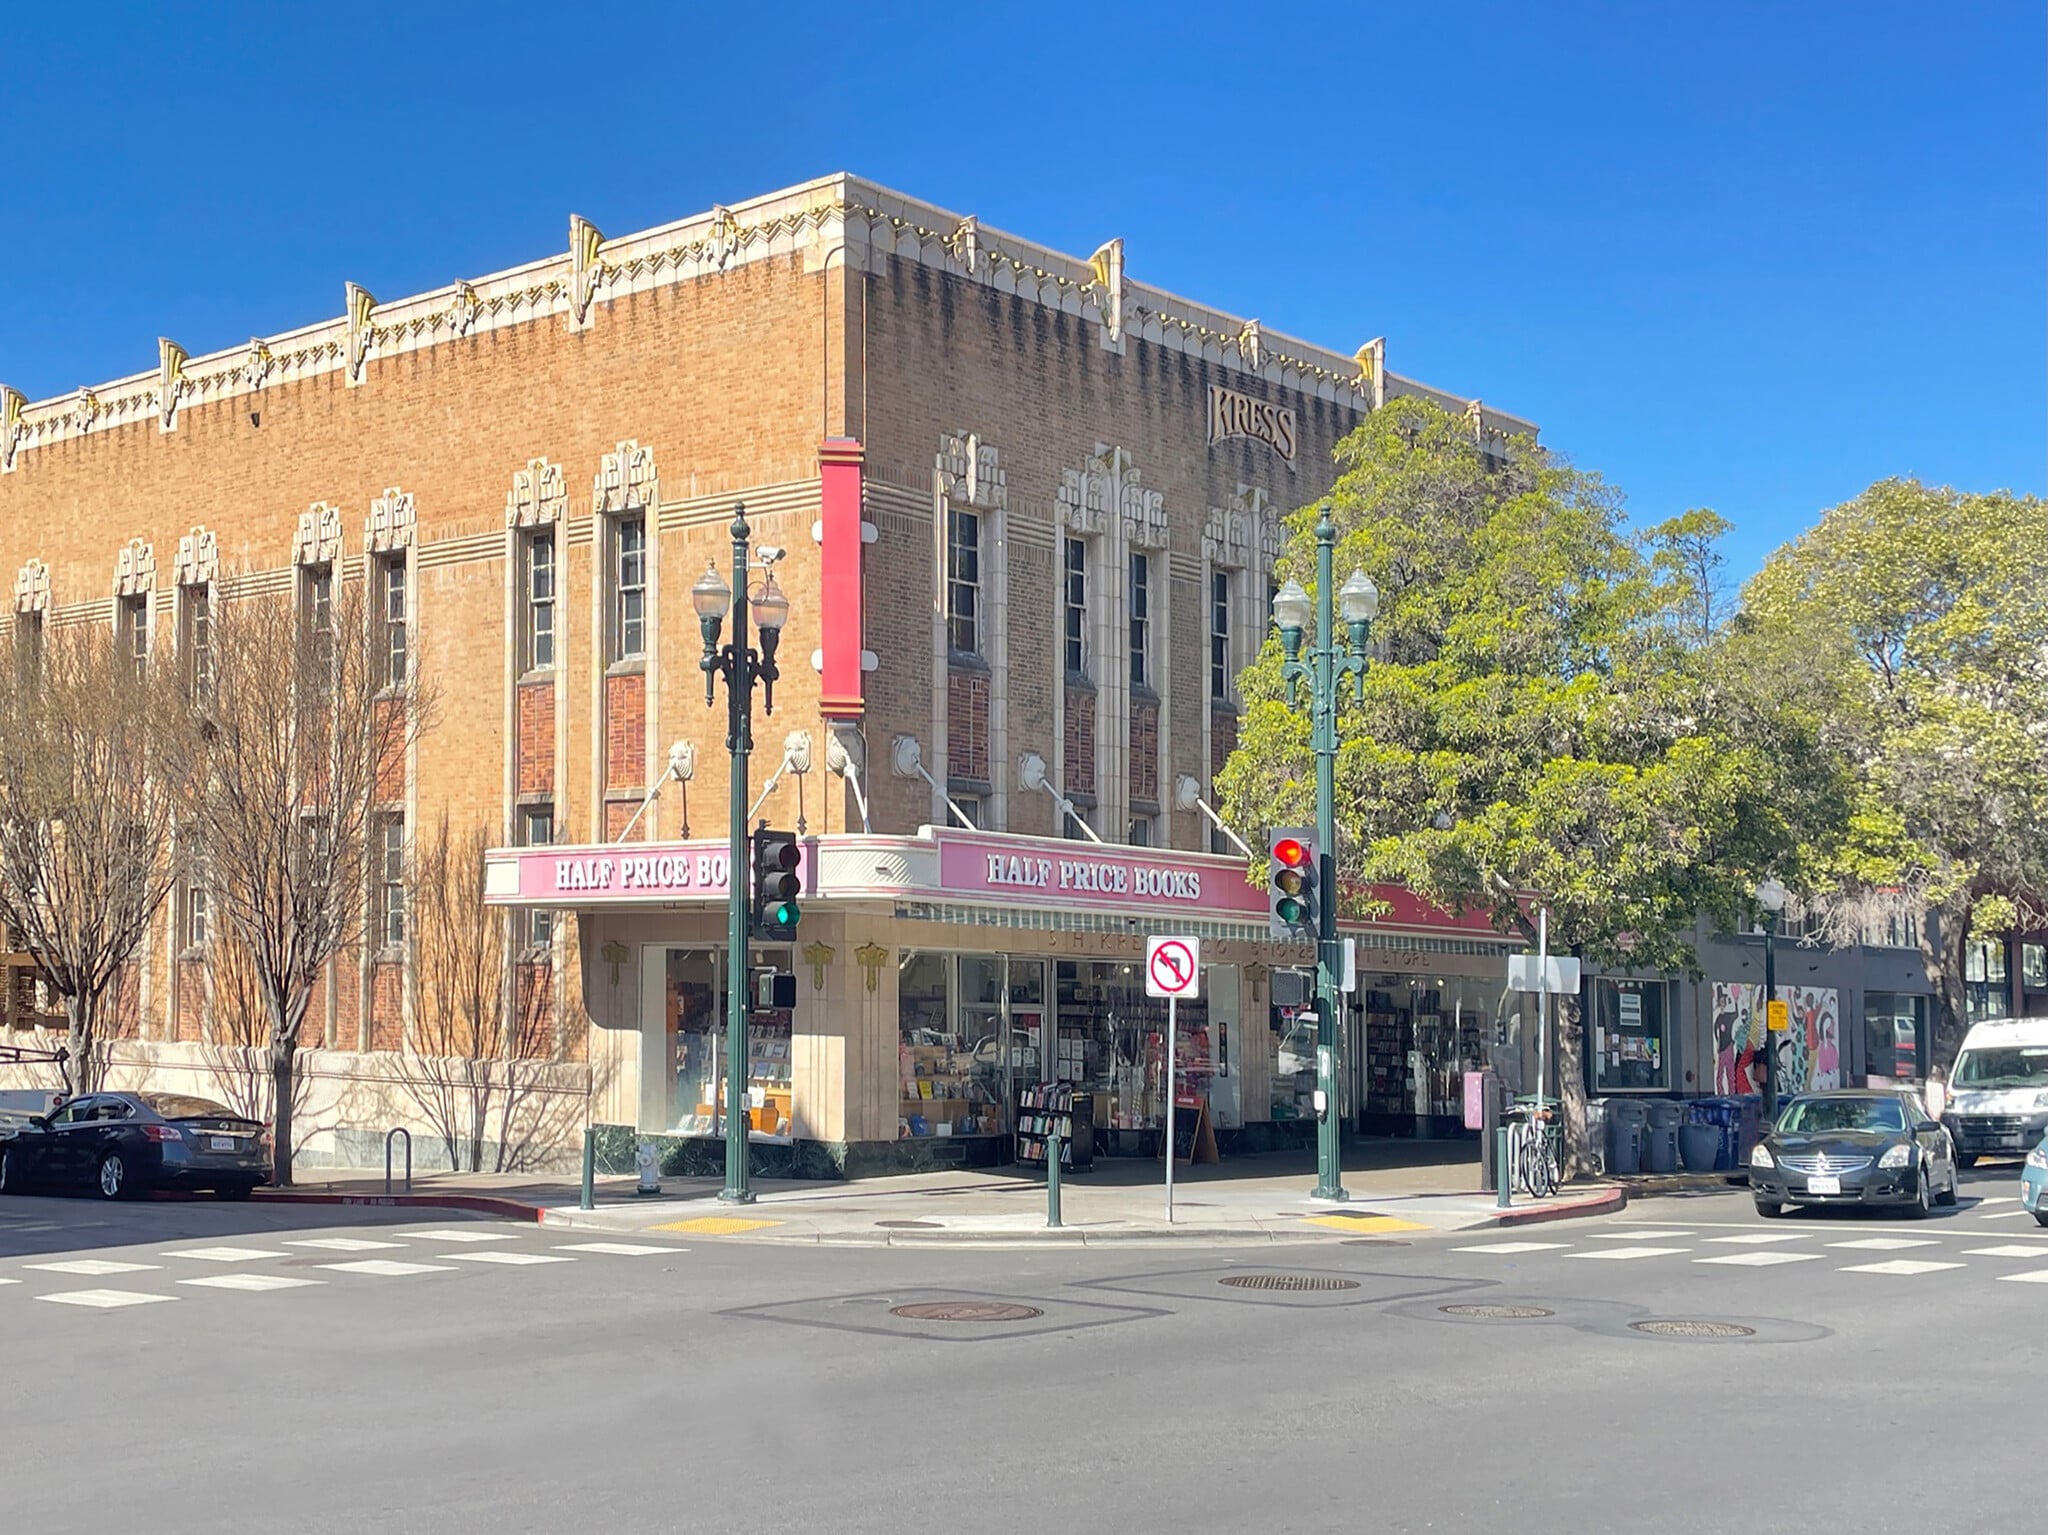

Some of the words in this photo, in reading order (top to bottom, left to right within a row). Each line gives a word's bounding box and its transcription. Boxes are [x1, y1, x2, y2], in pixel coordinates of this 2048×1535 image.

[1210, 386, 1296, 460] KRESS
[555, 857, 614, 890] HALF
[619, 855, 690, 888] PRICE
[987, 853, 1052, 887] HALF
[1059, 860, 1127, 893] PRICE
[1134, 867, 1201, 899] BOOKS
[1100, 933, 1143, 951] KRE
[1382, 951, 1430, 967] STORE
